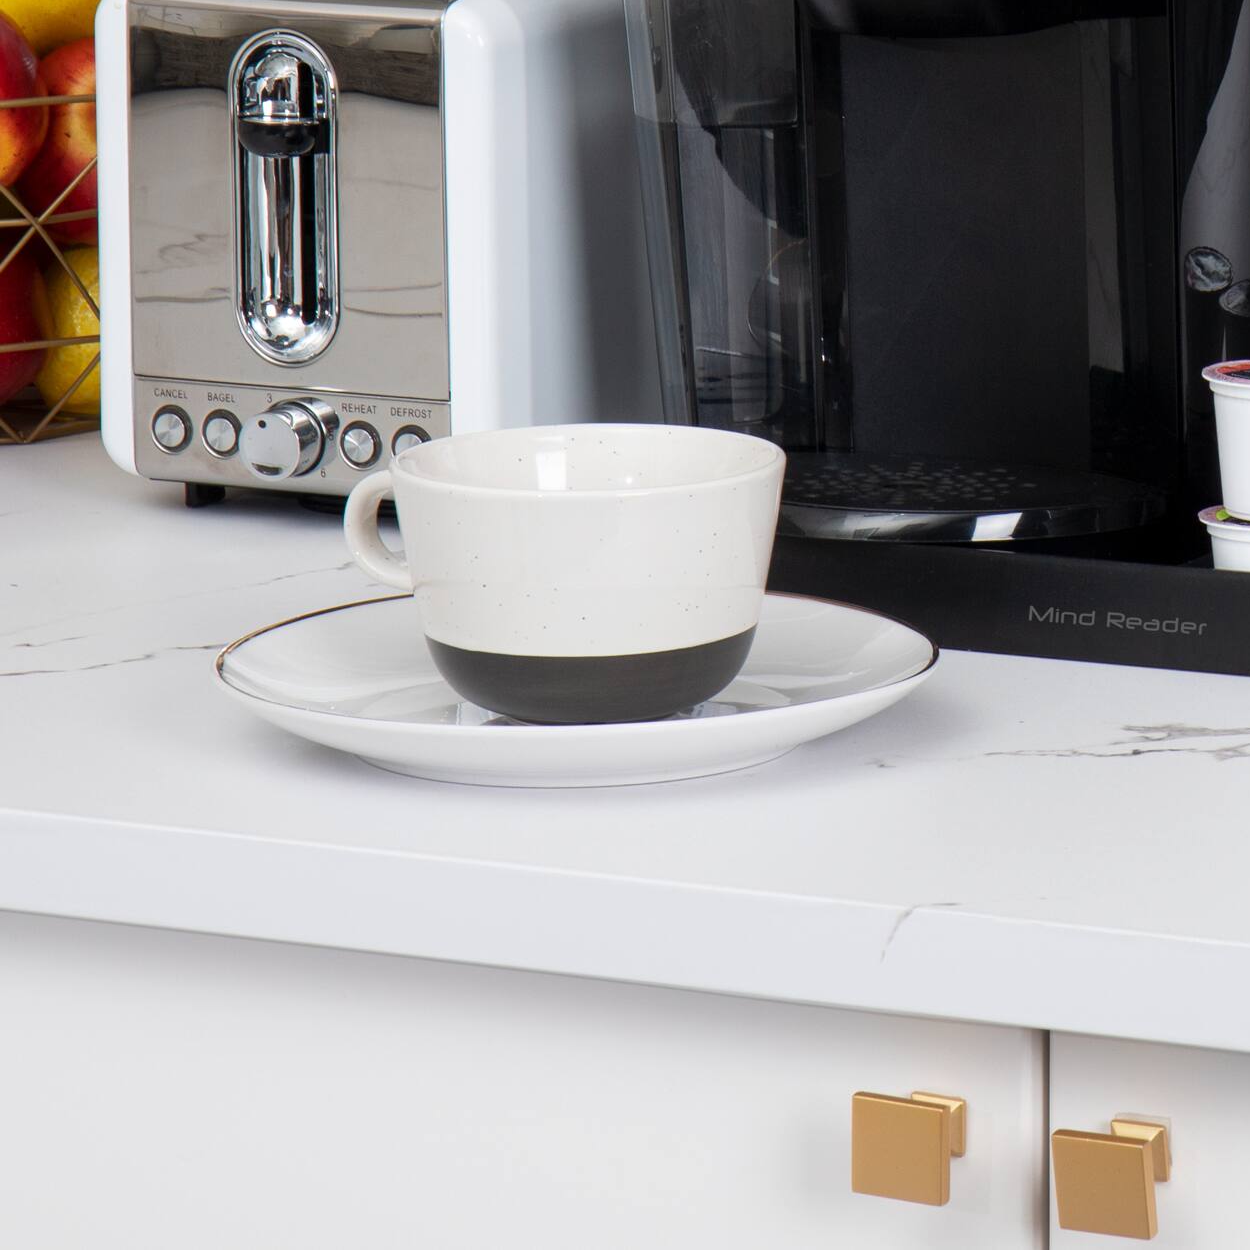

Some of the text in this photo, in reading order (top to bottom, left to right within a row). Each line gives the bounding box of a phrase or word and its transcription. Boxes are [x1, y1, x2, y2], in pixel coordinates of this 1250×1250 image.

[153, 387, 189, 400] CANCEL
[207, 392, 236, 404] BAGEL
[266, 393, 273, 403] 3
[341, 402, 377, 415] REHEAT
[390, 407, 433, 419] DEFROST
[1028, 605, 1208, 635] Mind Reader
